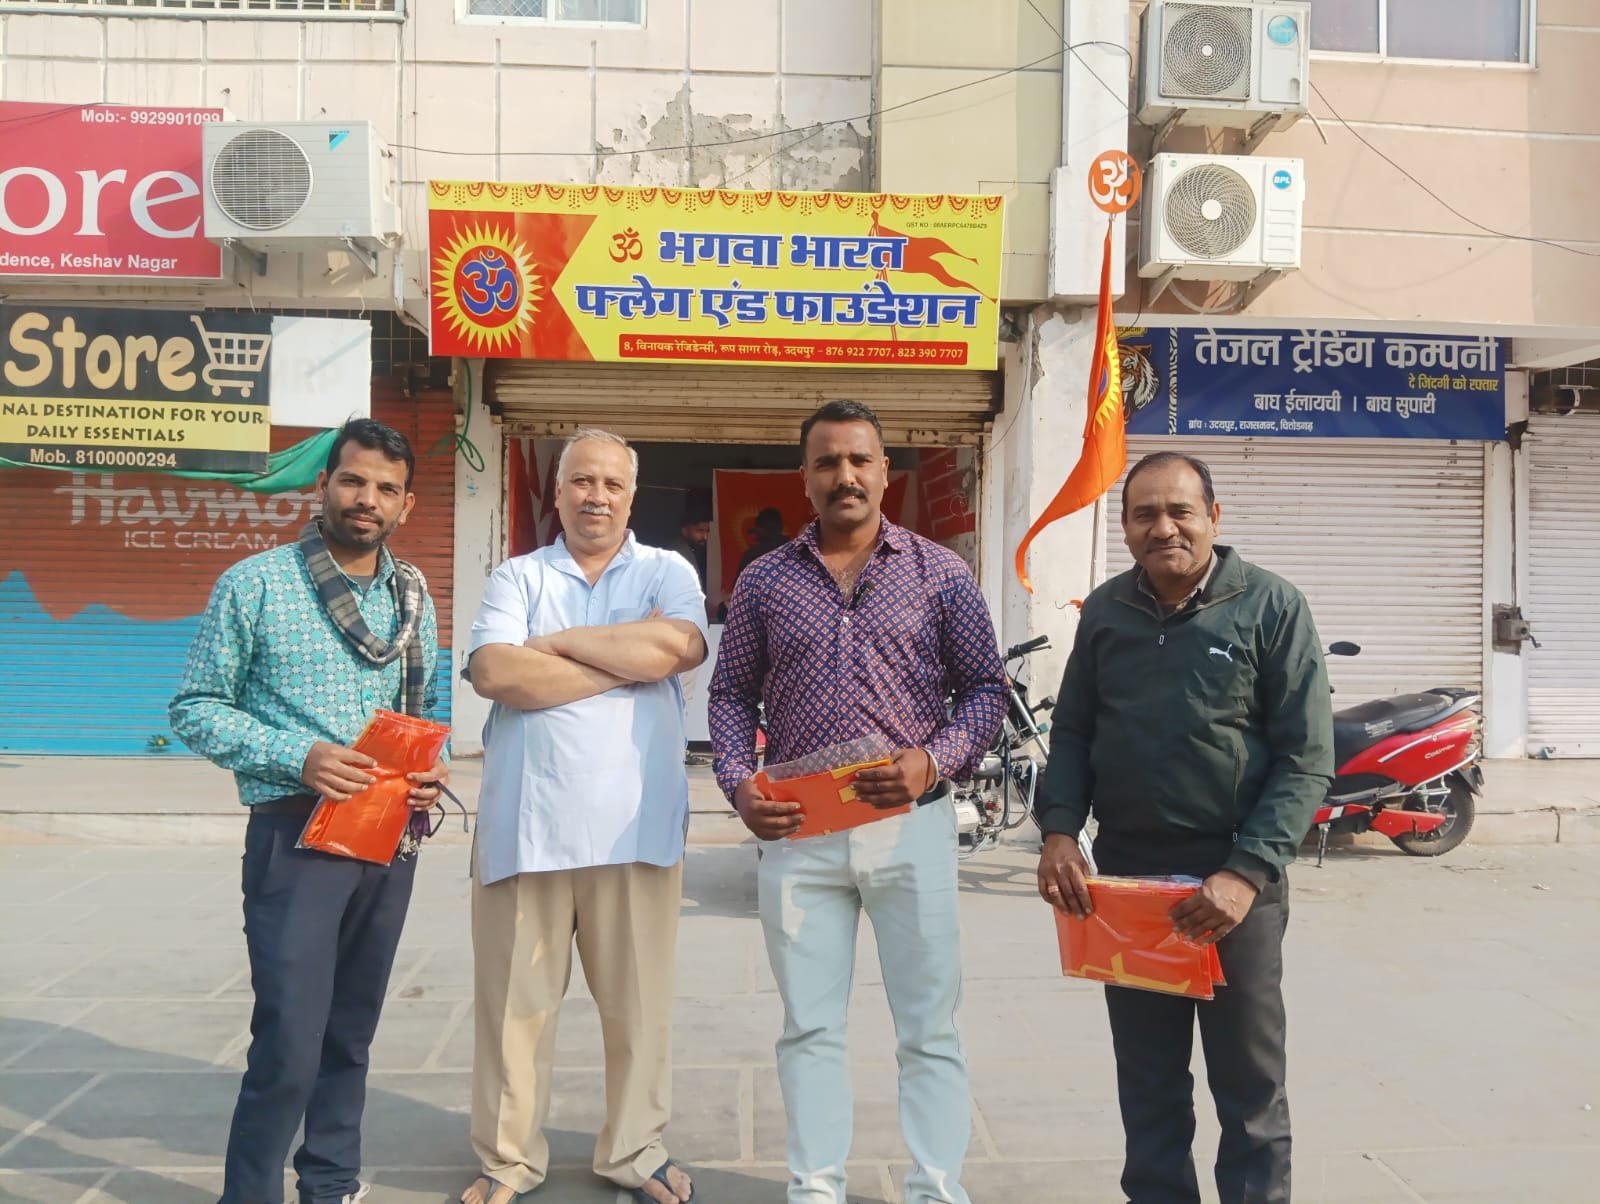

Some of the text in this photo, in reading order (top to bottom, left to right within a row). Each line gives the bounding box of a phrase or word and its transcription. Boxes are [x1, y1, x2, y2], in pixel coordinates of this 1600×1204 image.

[81, 109, 220, 125] Mob:- 9929901099
[658, 229, 783, 268] भगवा
[790, 234, 908, 271] भारत
[0, 252, 178, 272] dence, Keshav Nagar
[699, 279, 770, 329] एंड
[774, 280, 983, 328] फाउंडेशन
[4, 312, 196, 391] Store
[623, 341, 634, 353] 8,
[636, 339, 674, 353] विनायक
[738, 344, 761, 354] सागर
[784, 345, 815, 359] उदयपुर
[825, 346, 844, 356] 876
[847, 347, 865, 357] 922
[867, 347, 895, 358] 7707,
[897, 348, 915, 357] 823
[918, 348, 937, 358] 390
[939, 349, 964, 358] 7707
[1194, 328, 1282, 366] तेजल
[1408, 373, 1416, 389] दे
[1418, 373, 1449, 390] जिंदगी
[1452, 374, 1467, 390] को
[2, 403, 264, 424] NAL DESTINATION FOR YOUR
[1254, 394, 1281, 411] बाघ
[1284, 389, 1342, 413] ईलायची
[1365, 396, 1392, 413] बाघ
[1396, 392, 1436, 419] सुपारी
[26, 425, 186, 442] DAILY ESSENTIALS
[30, 448, 177, 467] Mob. 8100000294
[124, 531, 278, 550] ICE CREAM
